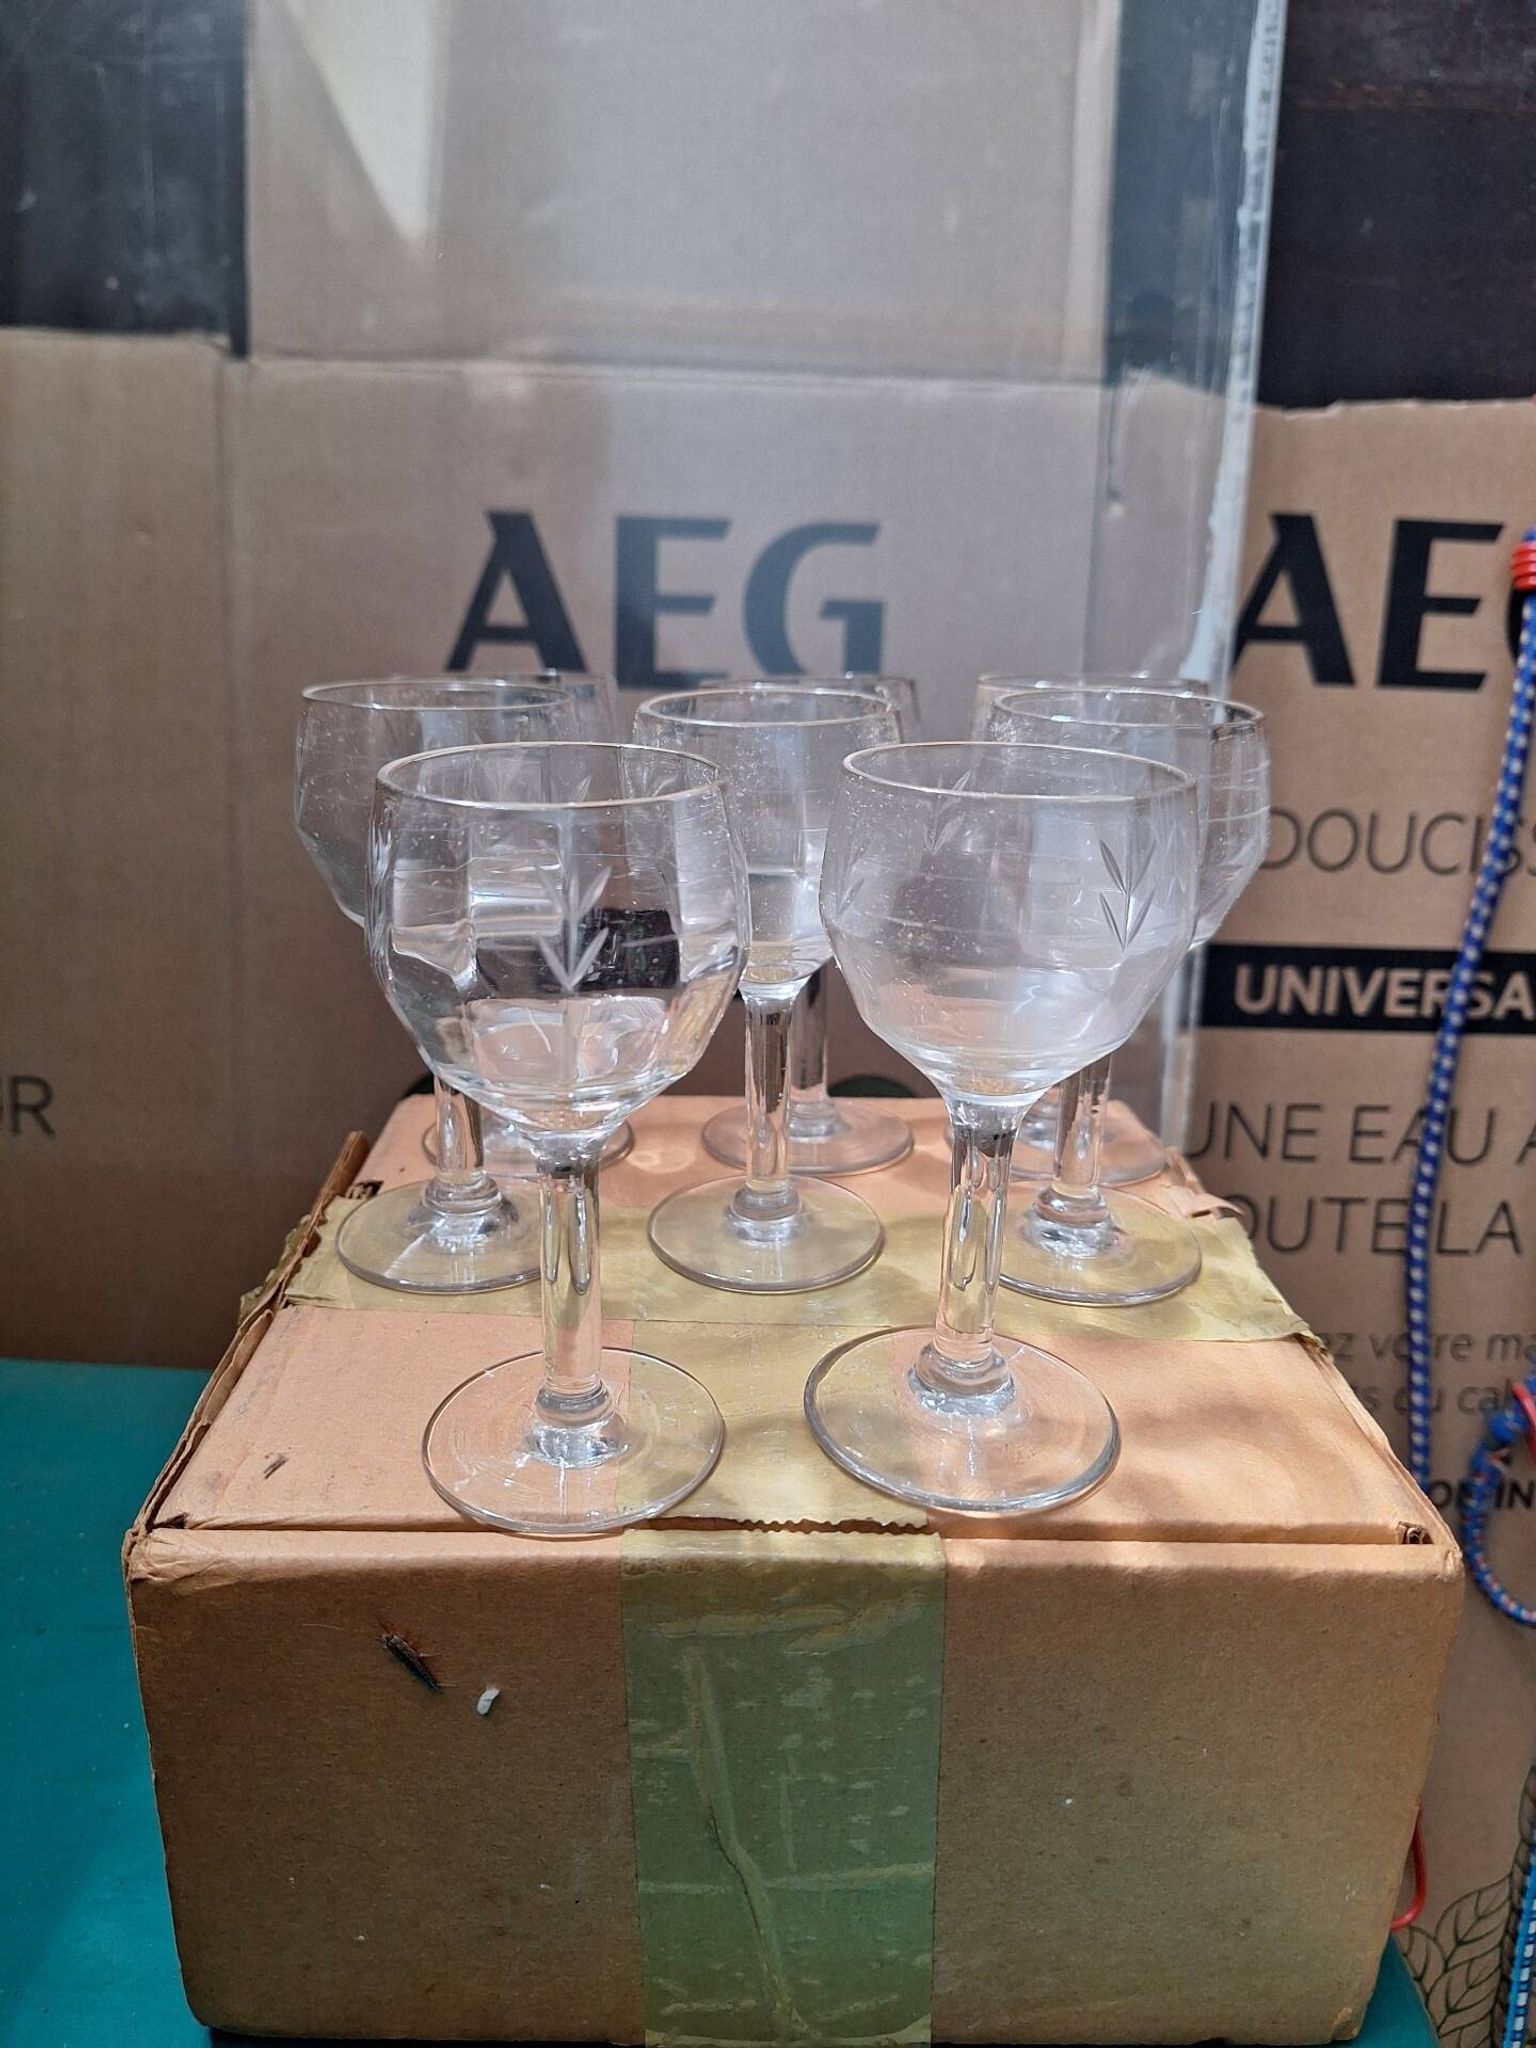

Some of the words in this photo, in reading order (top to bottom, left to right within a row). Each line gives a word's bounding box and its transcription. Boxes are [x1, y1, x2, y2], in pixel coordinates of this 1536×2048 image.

[444, 508, 886, 690] AEG
[0, 1073, 57, 1136] R
[1434, 1200, 1522, 1256] LA
